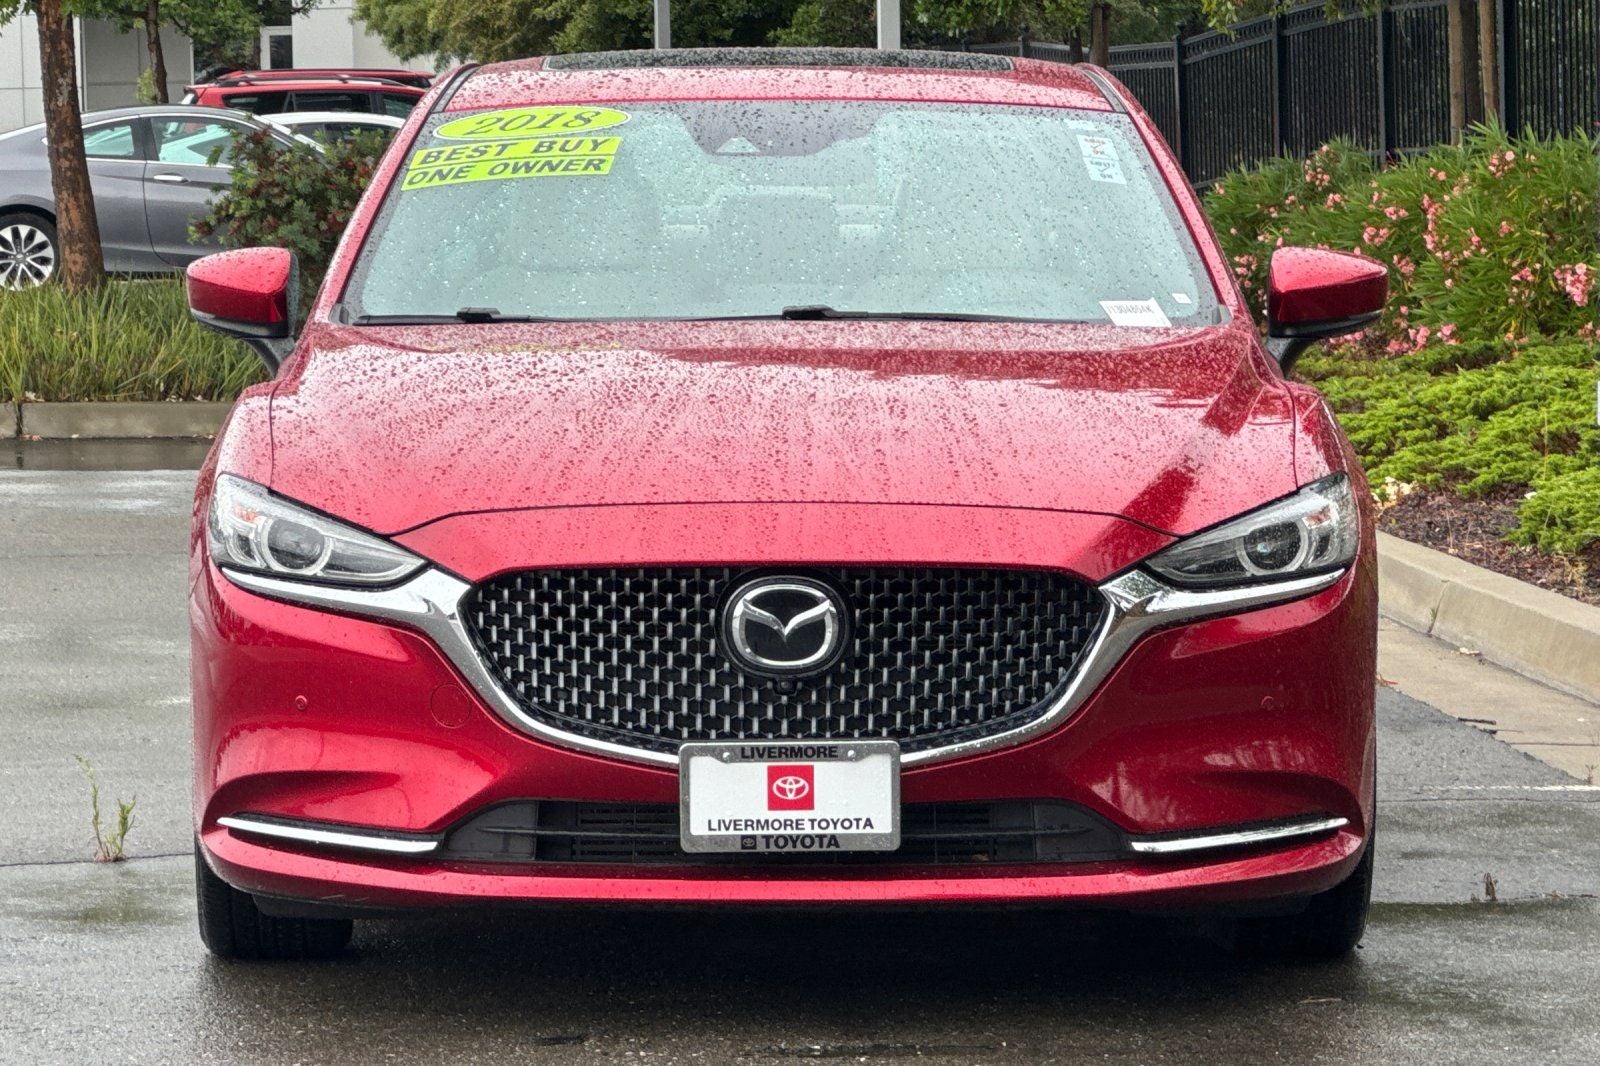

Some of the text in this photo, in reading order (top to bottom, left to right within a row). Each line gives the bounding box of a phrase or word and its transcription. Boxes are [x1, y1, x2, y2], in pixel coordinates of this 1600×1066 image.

[462, 110, 602, 136] 2018
[419, 138, 610, 166] BEST BUY
[407, 158, 609, 186] ONE OWNER
[741, 746, 838, 759] LIVERMORE
[708, 817, 874, 832] LIVERMORE TOYOTA
[761, 834, 840, 849] TOYOTA
